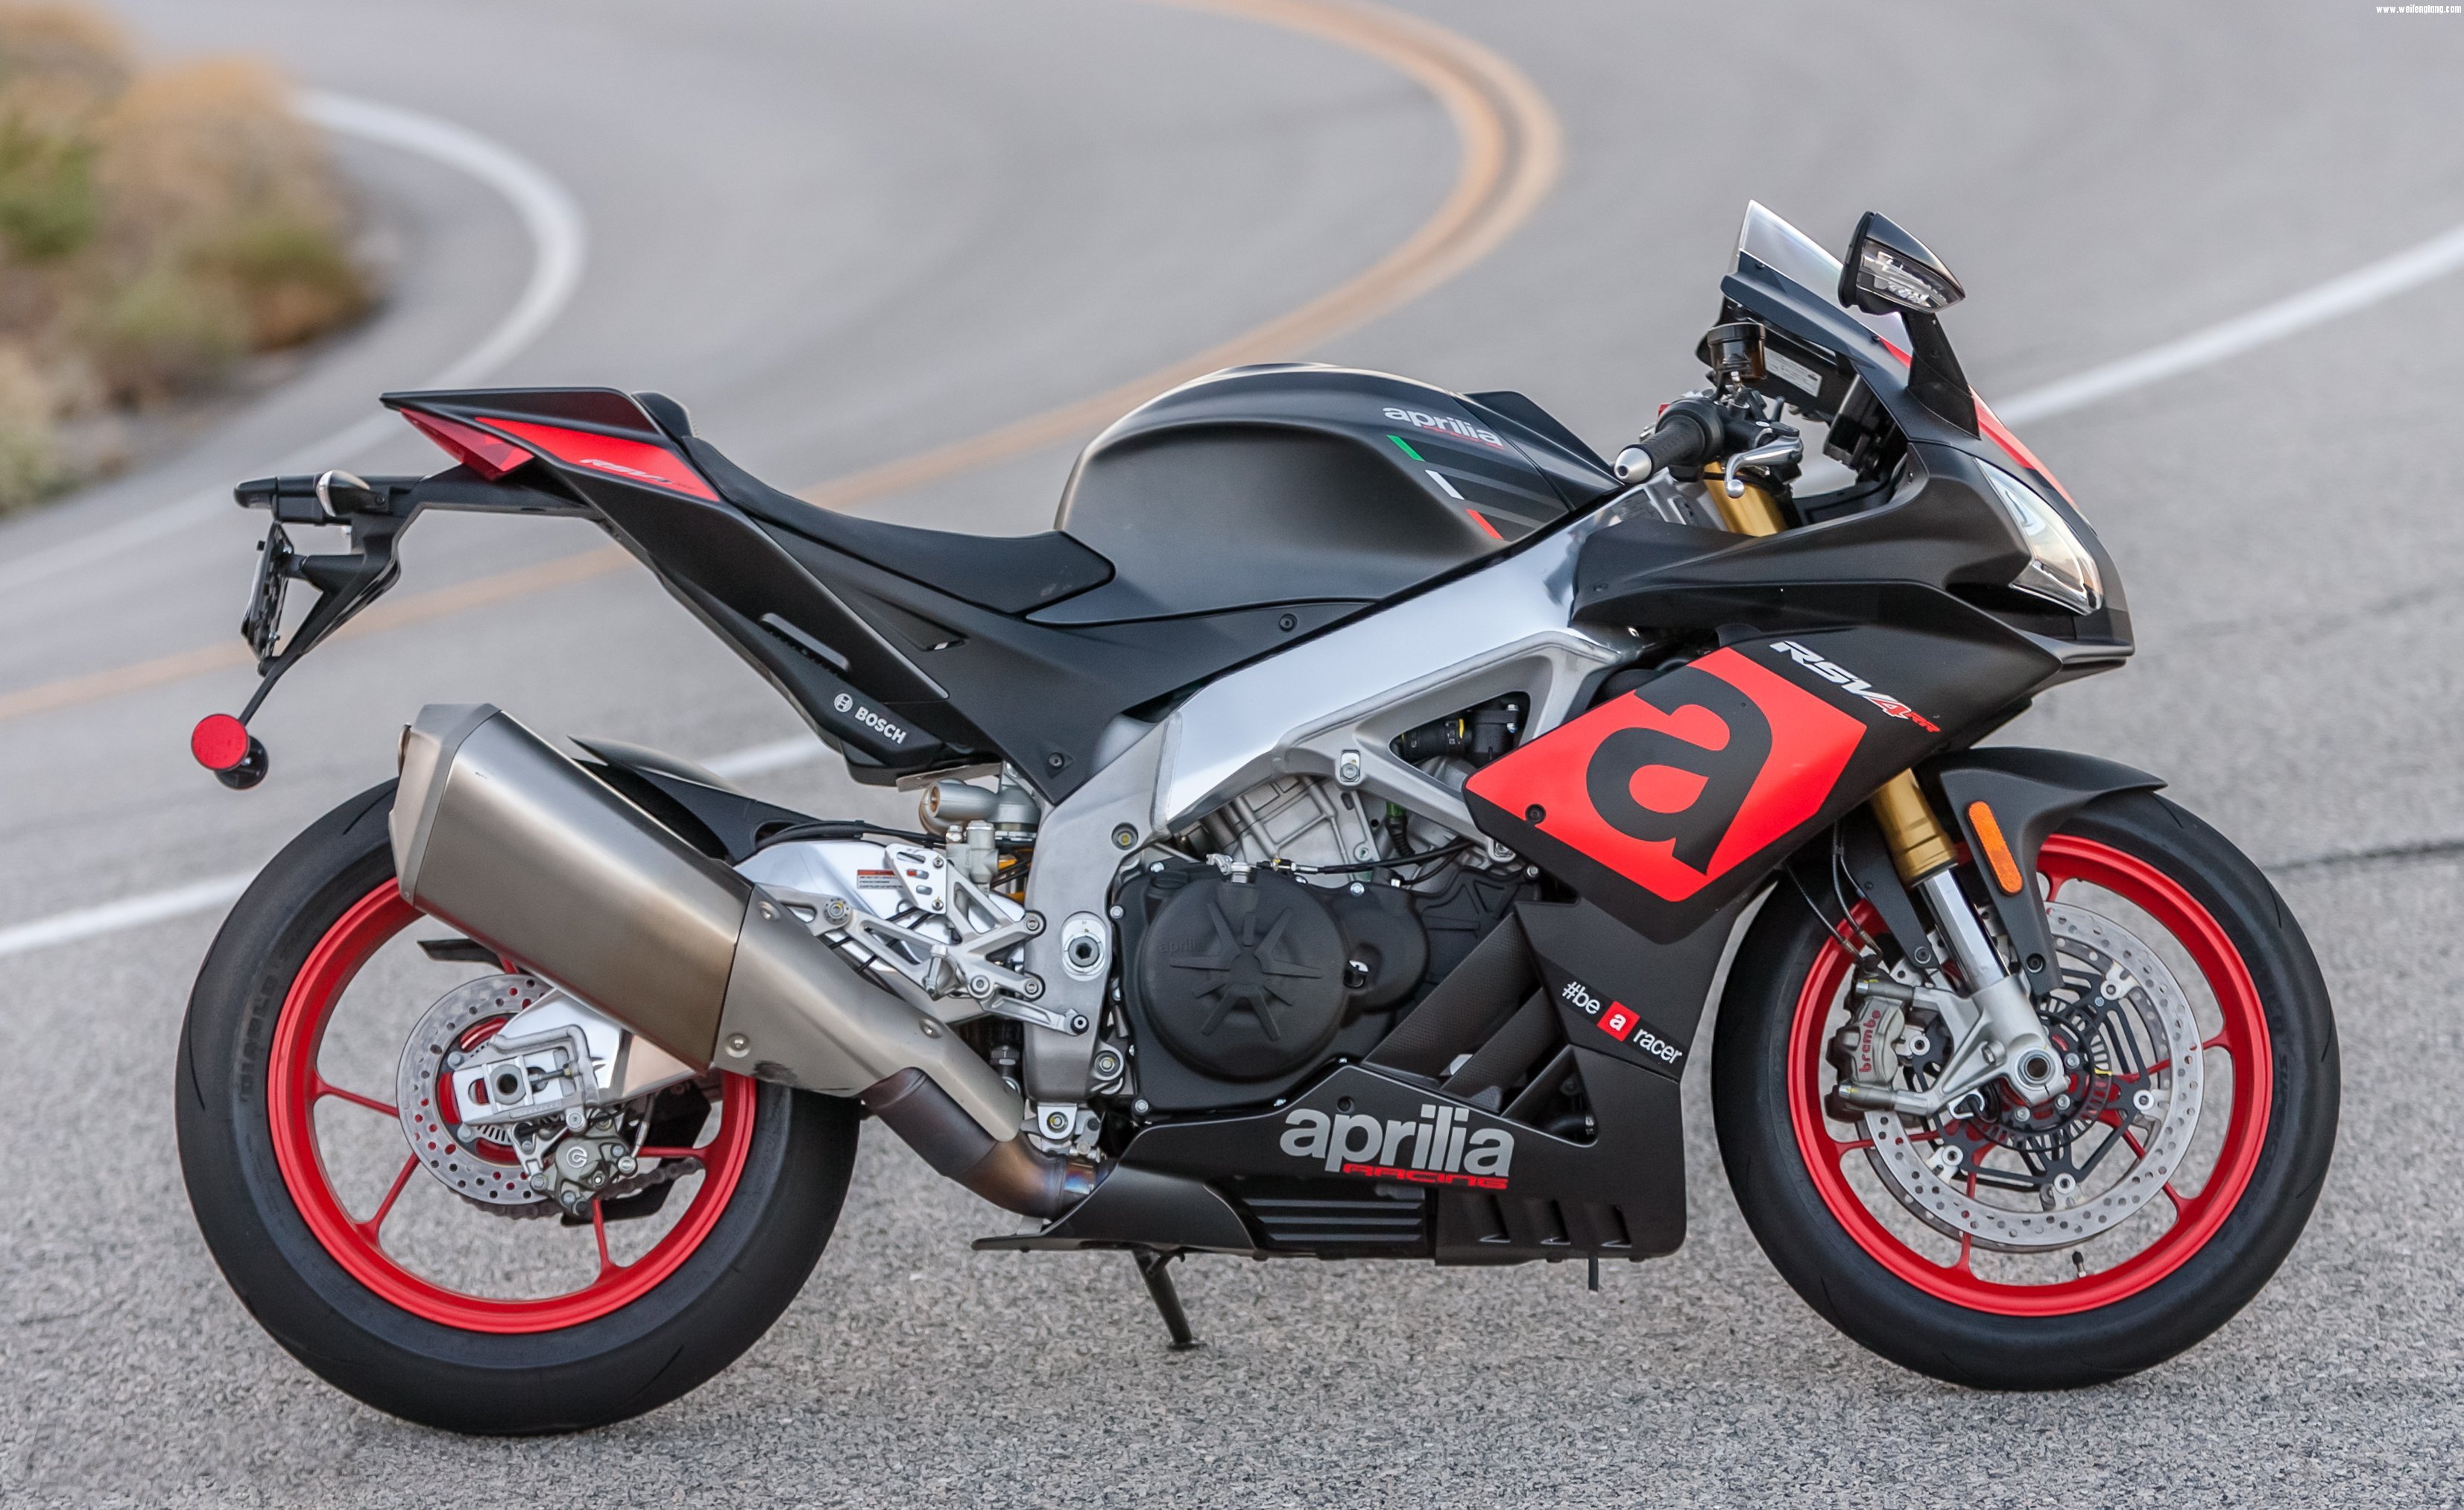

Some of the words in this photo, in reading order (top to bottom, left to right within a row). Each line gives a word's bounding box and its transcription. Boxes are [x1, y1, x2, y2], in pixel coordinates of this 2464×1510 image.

[1383, 407, 1503, 447] aprilia
[854, 706, 907, 745] BOSCH
[1561, 981, 1601, 1014] #be
[1608, 1014, 1627, 1032] a
[1632, 1029, 1683, 1064] racer
[1859, 1009, 1881, 1073] brembo
[1279, 1103, 1515, 1178] aprilia
